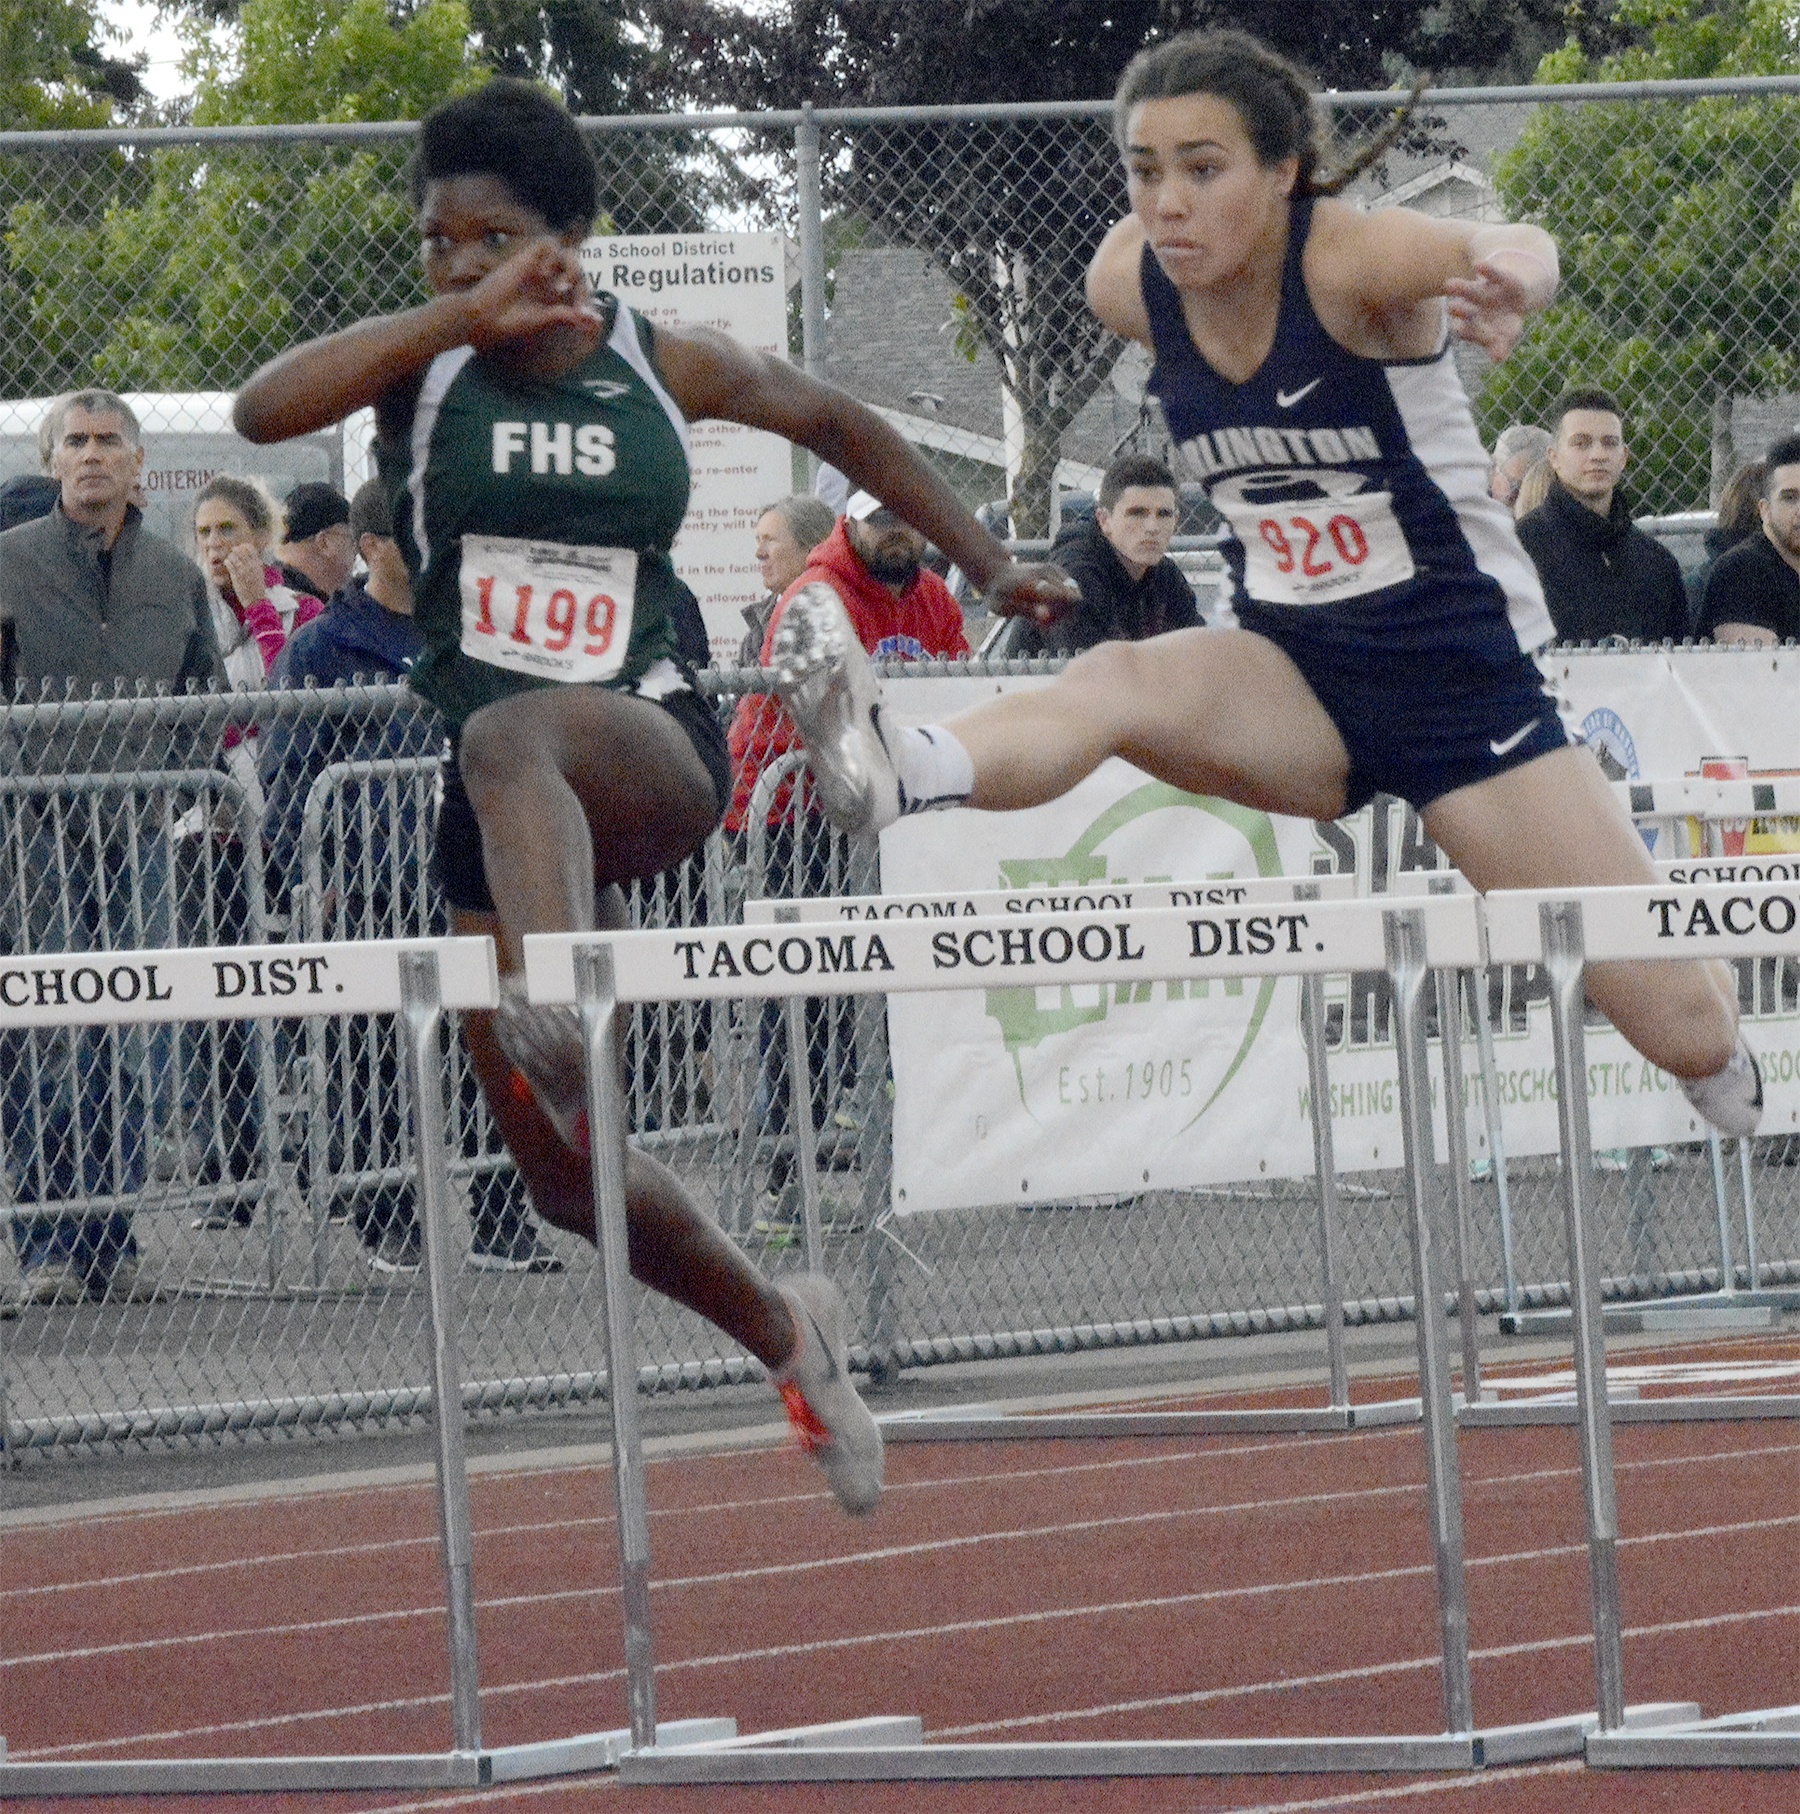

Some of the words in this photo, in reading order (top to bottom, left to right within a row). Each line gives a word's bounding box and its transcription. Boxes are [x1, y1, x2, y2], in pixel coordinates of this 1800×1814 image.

[609, 243, 666, 258] School
[672, 241, 734, 257] District
[612, 261, 774, 292] Regulations
[708, 425, 742, 434] other
[492, 421, 617, 476] FHS
[706, 465, 758, 475] re-enter
[708, 507, 729, 517] the
[733, 507, 759, 516] four
[723, 520, 746, 529] will
[1257, 513, 1369, 577] 920
[704, 565, 725, 574] the
[706, 593, 756, 602] allowed
[474, 575, 618, 657] 1199
[840, 901, 978, 920] TACOMA
[1005, 893, 1134, 914] SCHOOL
[1647, 894, 1800, 938] TACO
[673, 933, 895, 979] TACOMA
[931, 923, 1146, 969] SCHOOL
[1187, 914, 1325, 958] DIST.
[212, 956, 345, 998] DIST.
